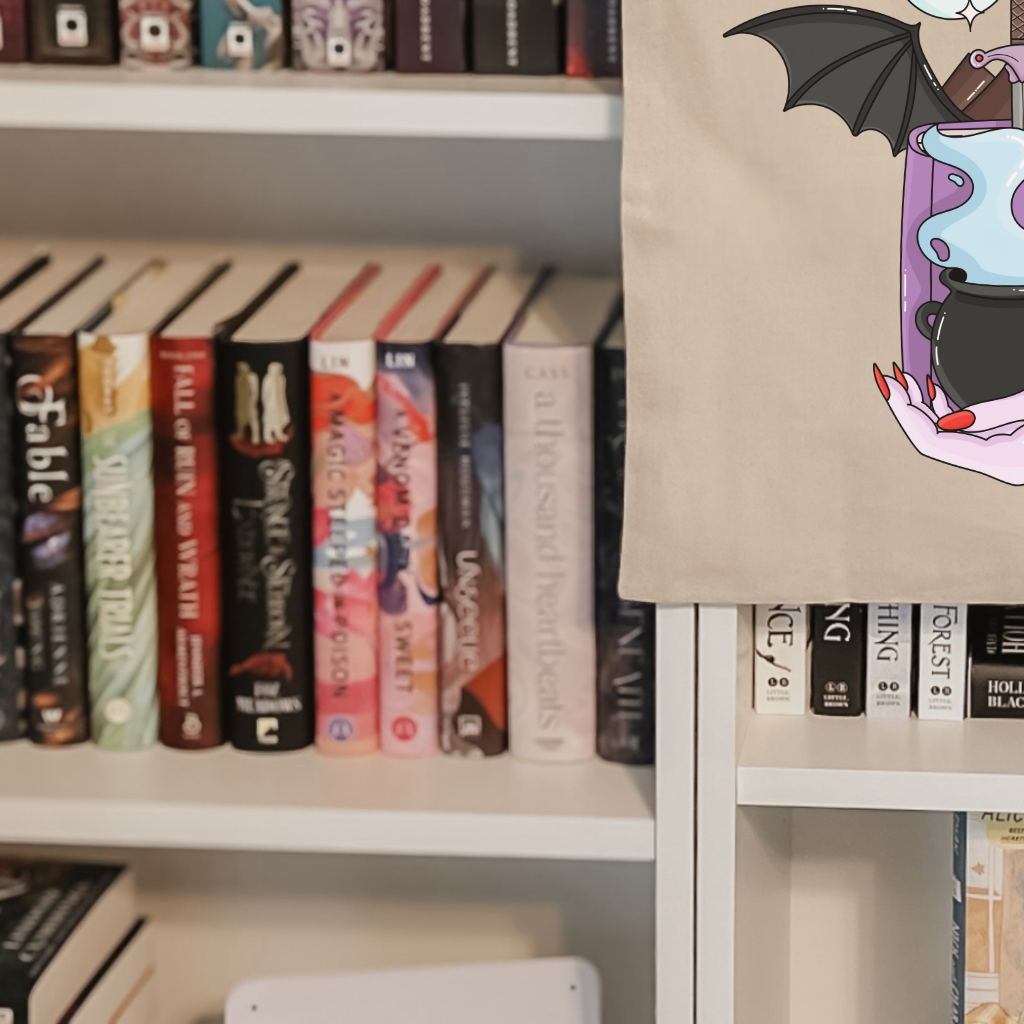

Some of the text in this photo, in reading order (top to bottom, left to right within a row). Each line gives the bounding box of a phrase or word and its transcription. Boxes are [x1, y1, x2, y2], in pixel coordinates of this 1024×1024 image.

[173, 364, 199, 417] FALL
[384, 353, 416, 370] LIN
[15, 374, 69, 506] Fable
[174, 444, 198, 497] RUIN
[326, 411, 347, 480] MAGIC
[176, 538, 201, 621] WRATH
[533, 390, 566, 728] a thousand heartbeats
[331, 617, 352, 699] POISON
[394, 620, 415, 696] SWEET
[928, 604, 958, 680] FOREST
